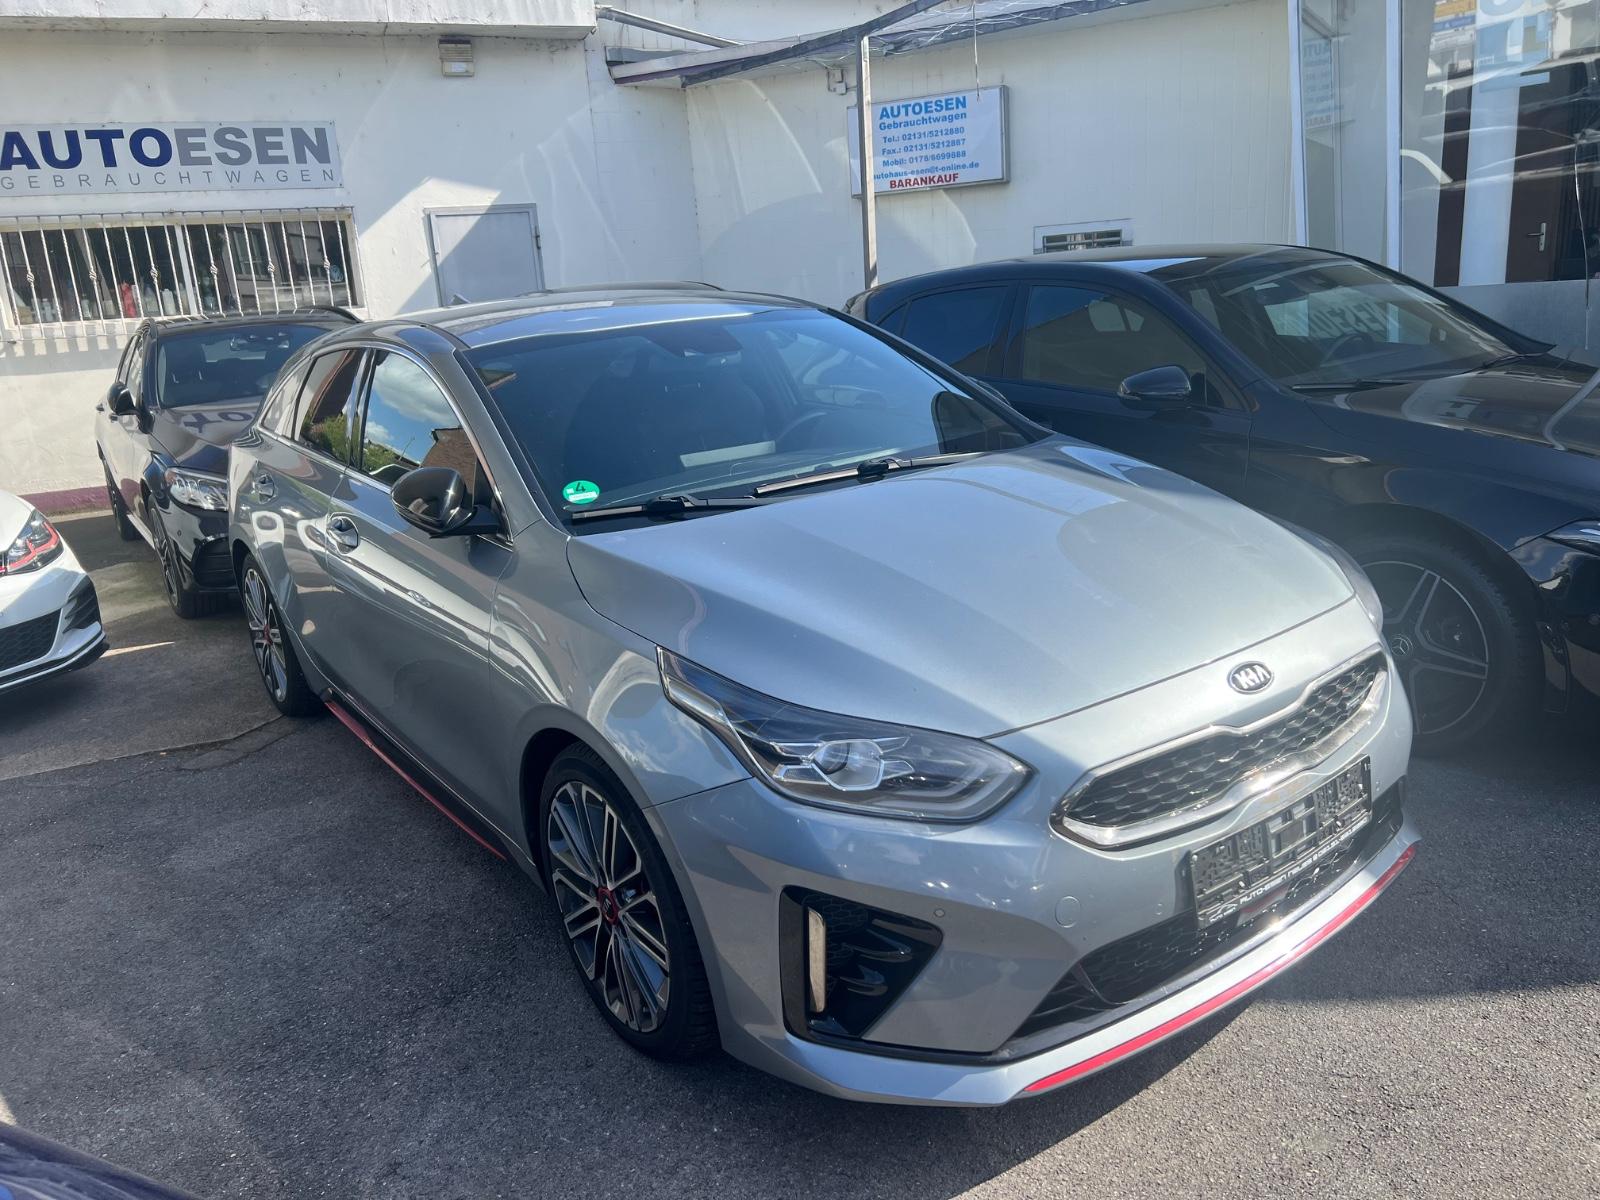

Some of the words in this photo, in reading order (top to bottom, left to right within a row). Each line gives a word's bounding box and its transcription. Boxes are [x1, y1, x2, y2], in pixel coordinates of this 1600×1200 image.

[880, 96, 967, 120] AUTOESEN
[879, 112, 967, 130] Gebrauchtwagen
[883, 135, 900, 143] Tel.:
[0, 127, 332, 171] AUTOESEN
[882, 157, 907, 167] Mobil:
[1, 169, 334, 190] GEBRAUCHTWAGEN
[890, 173, 959, 189] BARANKAUF
[575, 481, 587, 493] 4
[1232, 664, 1272, 690] KIA
